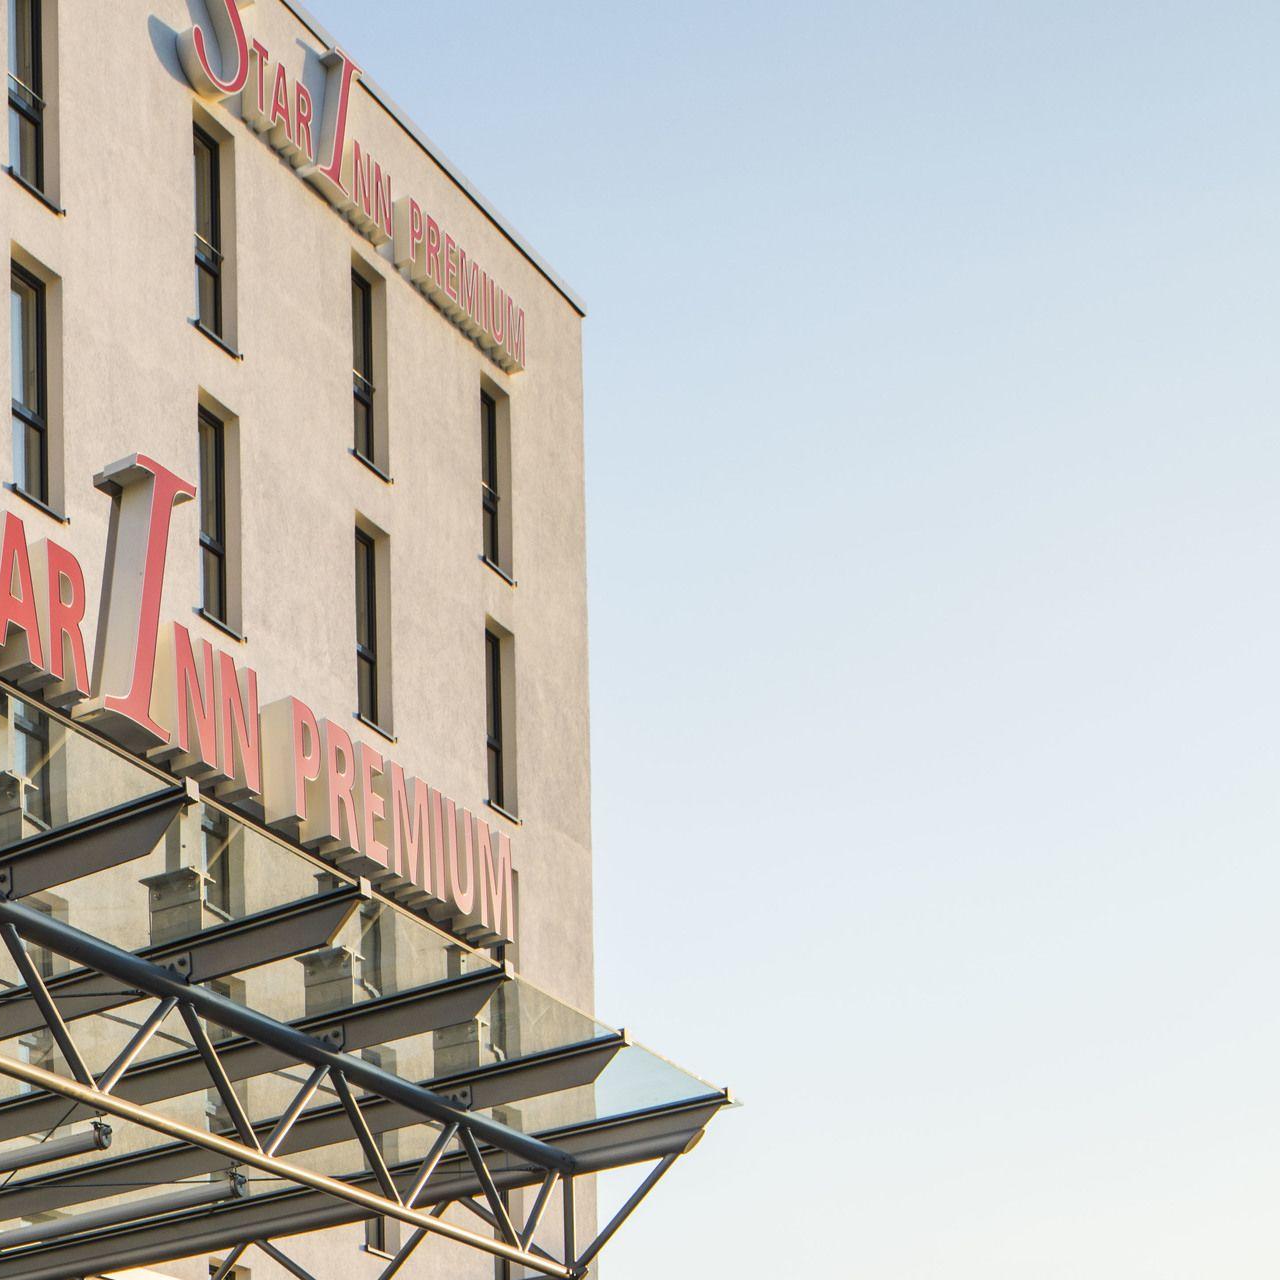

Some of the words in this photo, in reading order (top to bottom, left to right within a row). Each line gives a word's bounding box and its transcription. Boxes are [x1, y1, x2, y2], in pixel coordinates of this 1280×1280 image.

[317, 46, 393, 240] INN
[409, 196, 526, 369] PREMIUM
[103, 453, 261, 800] INN
[291, 695, 516, 945] PREMIUM
